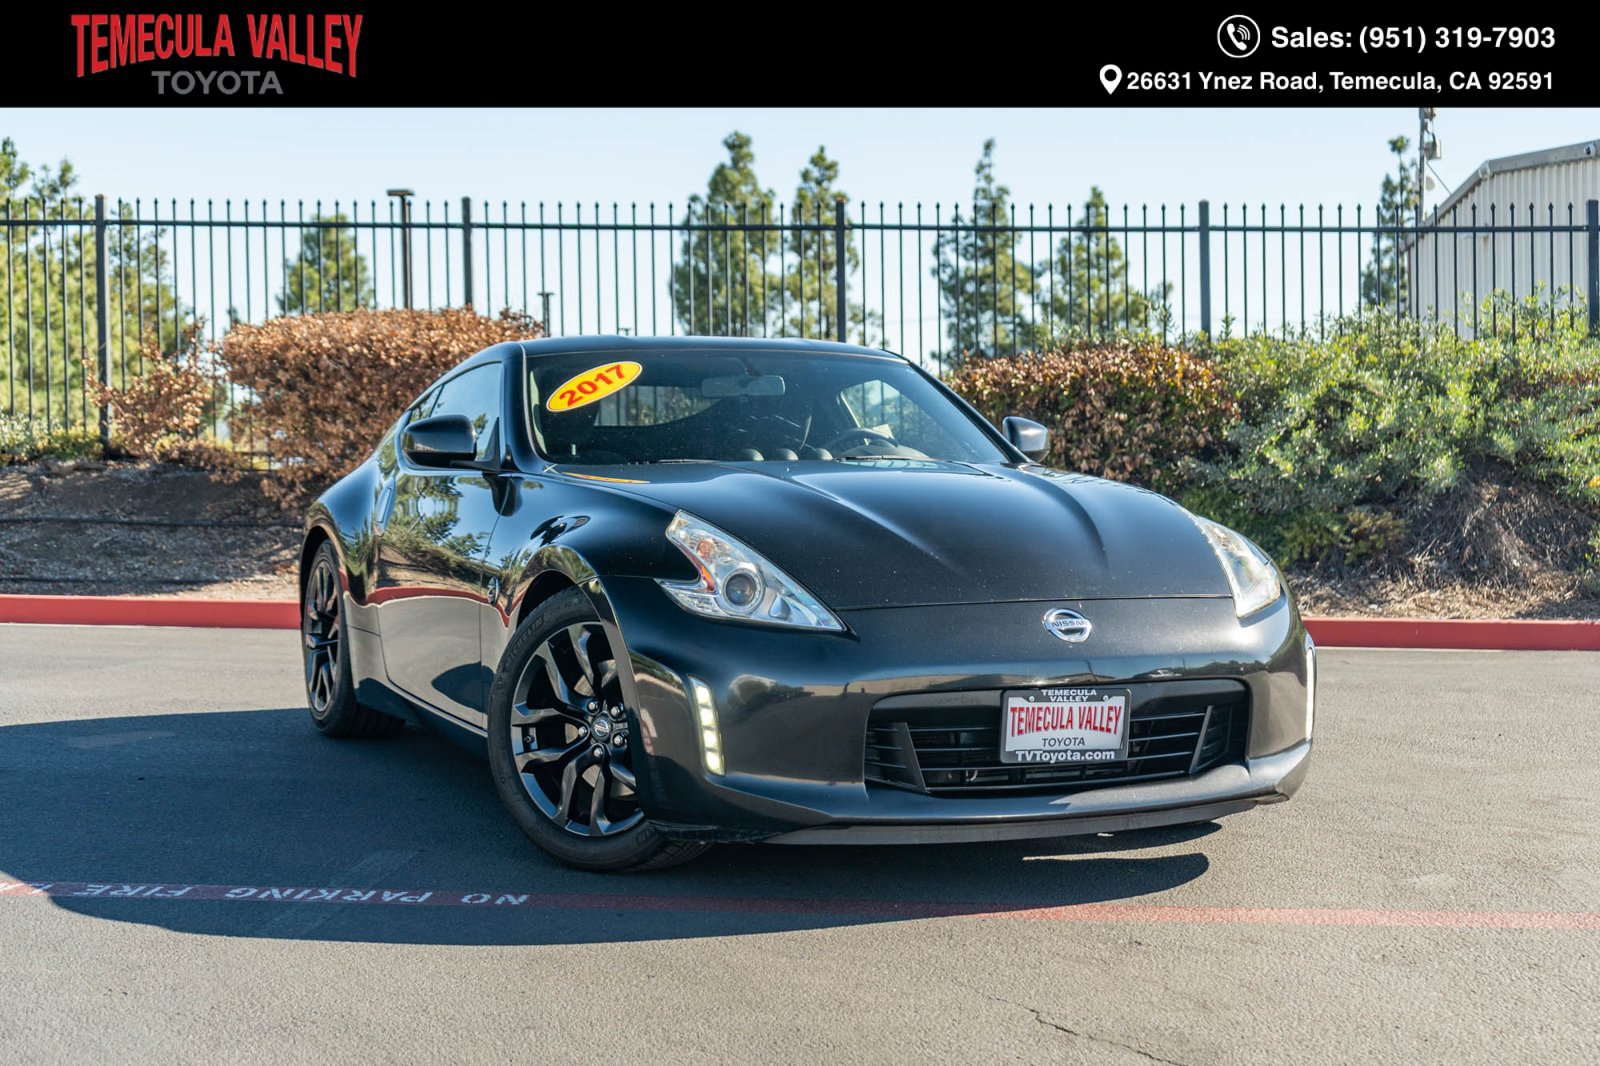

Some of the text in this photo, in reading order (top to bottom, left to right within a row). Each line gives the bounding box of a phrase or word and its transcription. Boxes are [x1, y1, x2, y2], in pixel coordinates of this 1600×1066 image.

[558, 364, 626, 406] 2017
[1010, 705, 1122, 737] TEMECULA VALLEY
[1041, 737, 1086, 747] TOYOTA
[1016, 750, 1115, 763] TVToyota.com
[73, 884, 193, 897] FIRE
[224, 887, 434, 903] PARKING
[460, 893, 530, 905] NO
